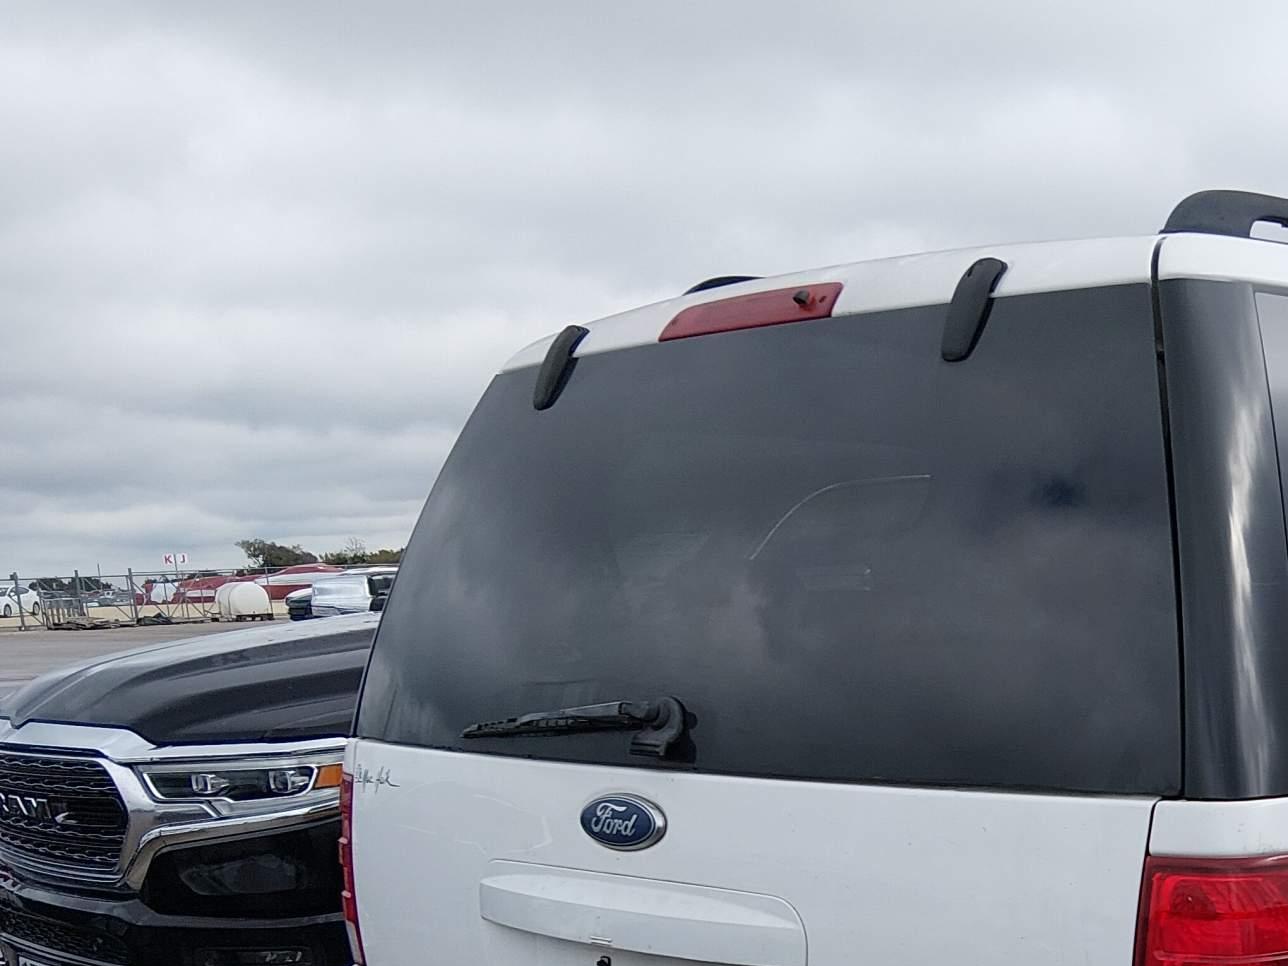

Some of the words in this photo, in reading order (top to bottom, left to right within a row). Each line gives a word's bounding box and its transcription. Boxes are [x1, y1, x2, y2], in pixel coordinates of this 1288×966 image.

[164, 554, 173, 565] K
[180, 554, 186, 564] J
[590, 802, 638, 837] Ford
